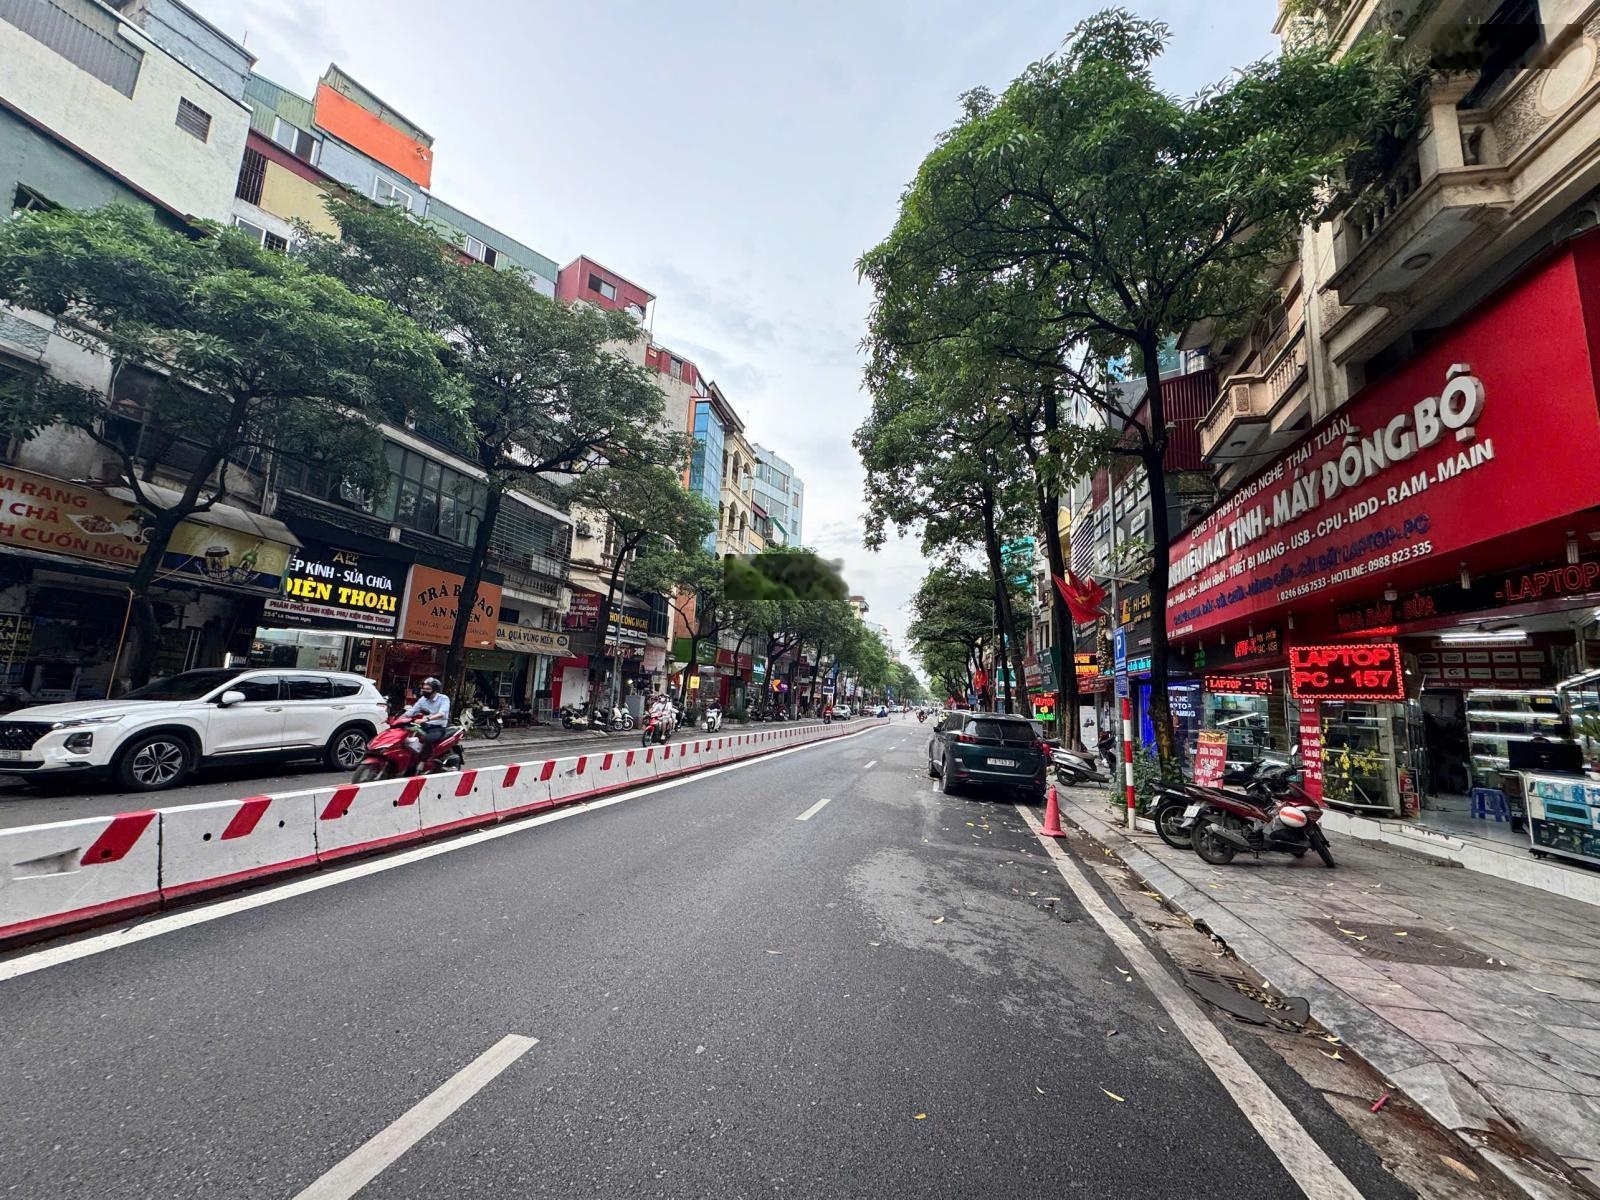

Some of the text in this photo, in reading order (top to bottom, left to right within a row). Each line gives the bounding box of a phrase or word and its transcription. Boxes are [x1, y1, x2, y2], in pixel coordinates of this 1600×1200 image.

[1181, 543, 1203, 581] KIỆN
[1203, 523, 1228, 565] MÁY
[1229, 507, 1264, 550] TÍNH
[1273, 466, 1319, 527] MÁY
[1321, 414, 1416, 500] ĐỒNG
[1413, 363, 1485, 449] BỘ
[1207, 515, 1216, 528] TY
[1216, 502, 1234, 520] TNHH
[1234, 487, 1257, 507] CÔNG
[1258, 463, 1284, 490] NGHỆ
[1286, 437, 1313, 470] THÁI
[1314, 414, 1351, 450] TUẤN
[20, 481, 88, 509] RANG
[1228, 555, 1247, 579] THIẾT
[1247, 555, 1257, 571] BỊ
[1257, 541, 1286, 566] MẠNG
[1290, 529, 1311, 550] USB
[1316, 512, 1343, 537] CPU
[1348, 496, 1379, 524] HDD
[1386, 471, 1428, 506] RAM
[1436, 438, 1496, 483] MAIN
[9, 502, 60, 523] CHẢ
[20, 527, 89, 552] CUỐN
[94, 542, 140, 561] NÓN
[1343, 527, 1397, 562] LAPTOP
[1403, 513, 1431, 540] PC
[305, 561, 335, 579] KÍNH
[343, 567, 364, 586] SỬA
[365, 575, 393, 592] CHỮA
[1331, 564, 1369, 585] HOTLINE:
[1367, 554, 1391, 573] 0988
[1391, 547, 1413, 565] 823
[1411, 540, 1433, 559] 335
[1504, 562, 1600, 601] LAPTOP
[338, 586, 398, 614] THOẠI
[431, 606, 448, 617] AN
[1132, 592, 1152, 611] HI-EN
[1115, 635, 1122, 658] P
[1293, 648, 1391, 668] LAPTOP
[1209, 679, 1242, 690] LAPTOP
[1255, 681, 1268, 690] PC
[1294, 670, 1393, 688] PC 157
